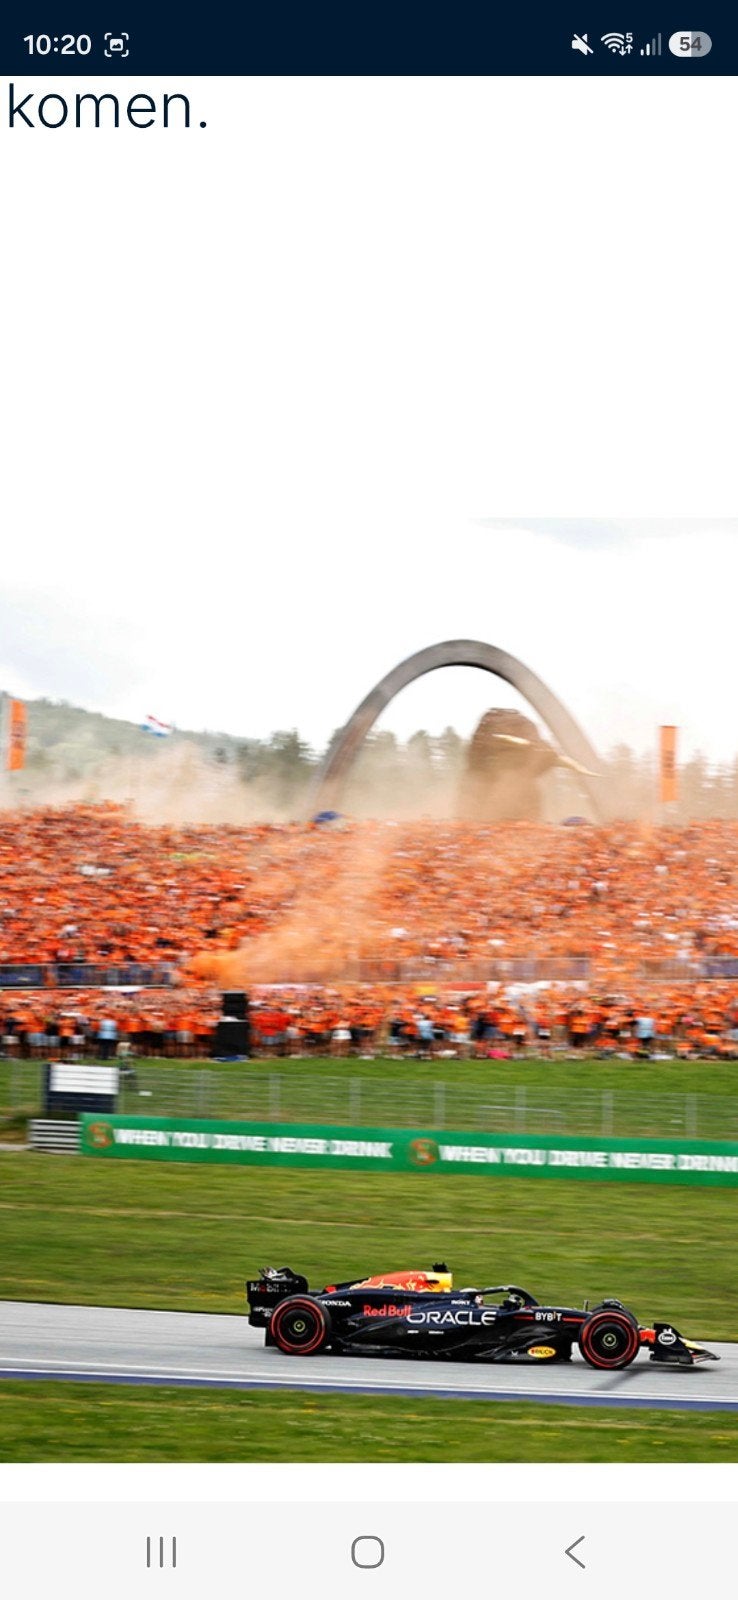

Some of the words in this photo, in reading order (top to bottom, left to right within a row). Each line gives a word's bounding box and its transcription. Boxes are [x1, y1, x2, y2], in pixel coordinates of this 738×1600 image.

[24, 34, 92, 55] 10:20
[679, 37, 702, 51] 54
[9, 83, 207, 128] komen.
[113, 1129, 169, 1146] WHEN
[438, 1145, 500, 1163] WHEN
[502, 1149, 545, 1165] YOU
[609, 1152, 674, 1169] NEVER
[363, 1304, 387, 1317] Red
[387, 1305, 412, 1317] Bull
[406, 1310, 497, 1326] ORACLE
